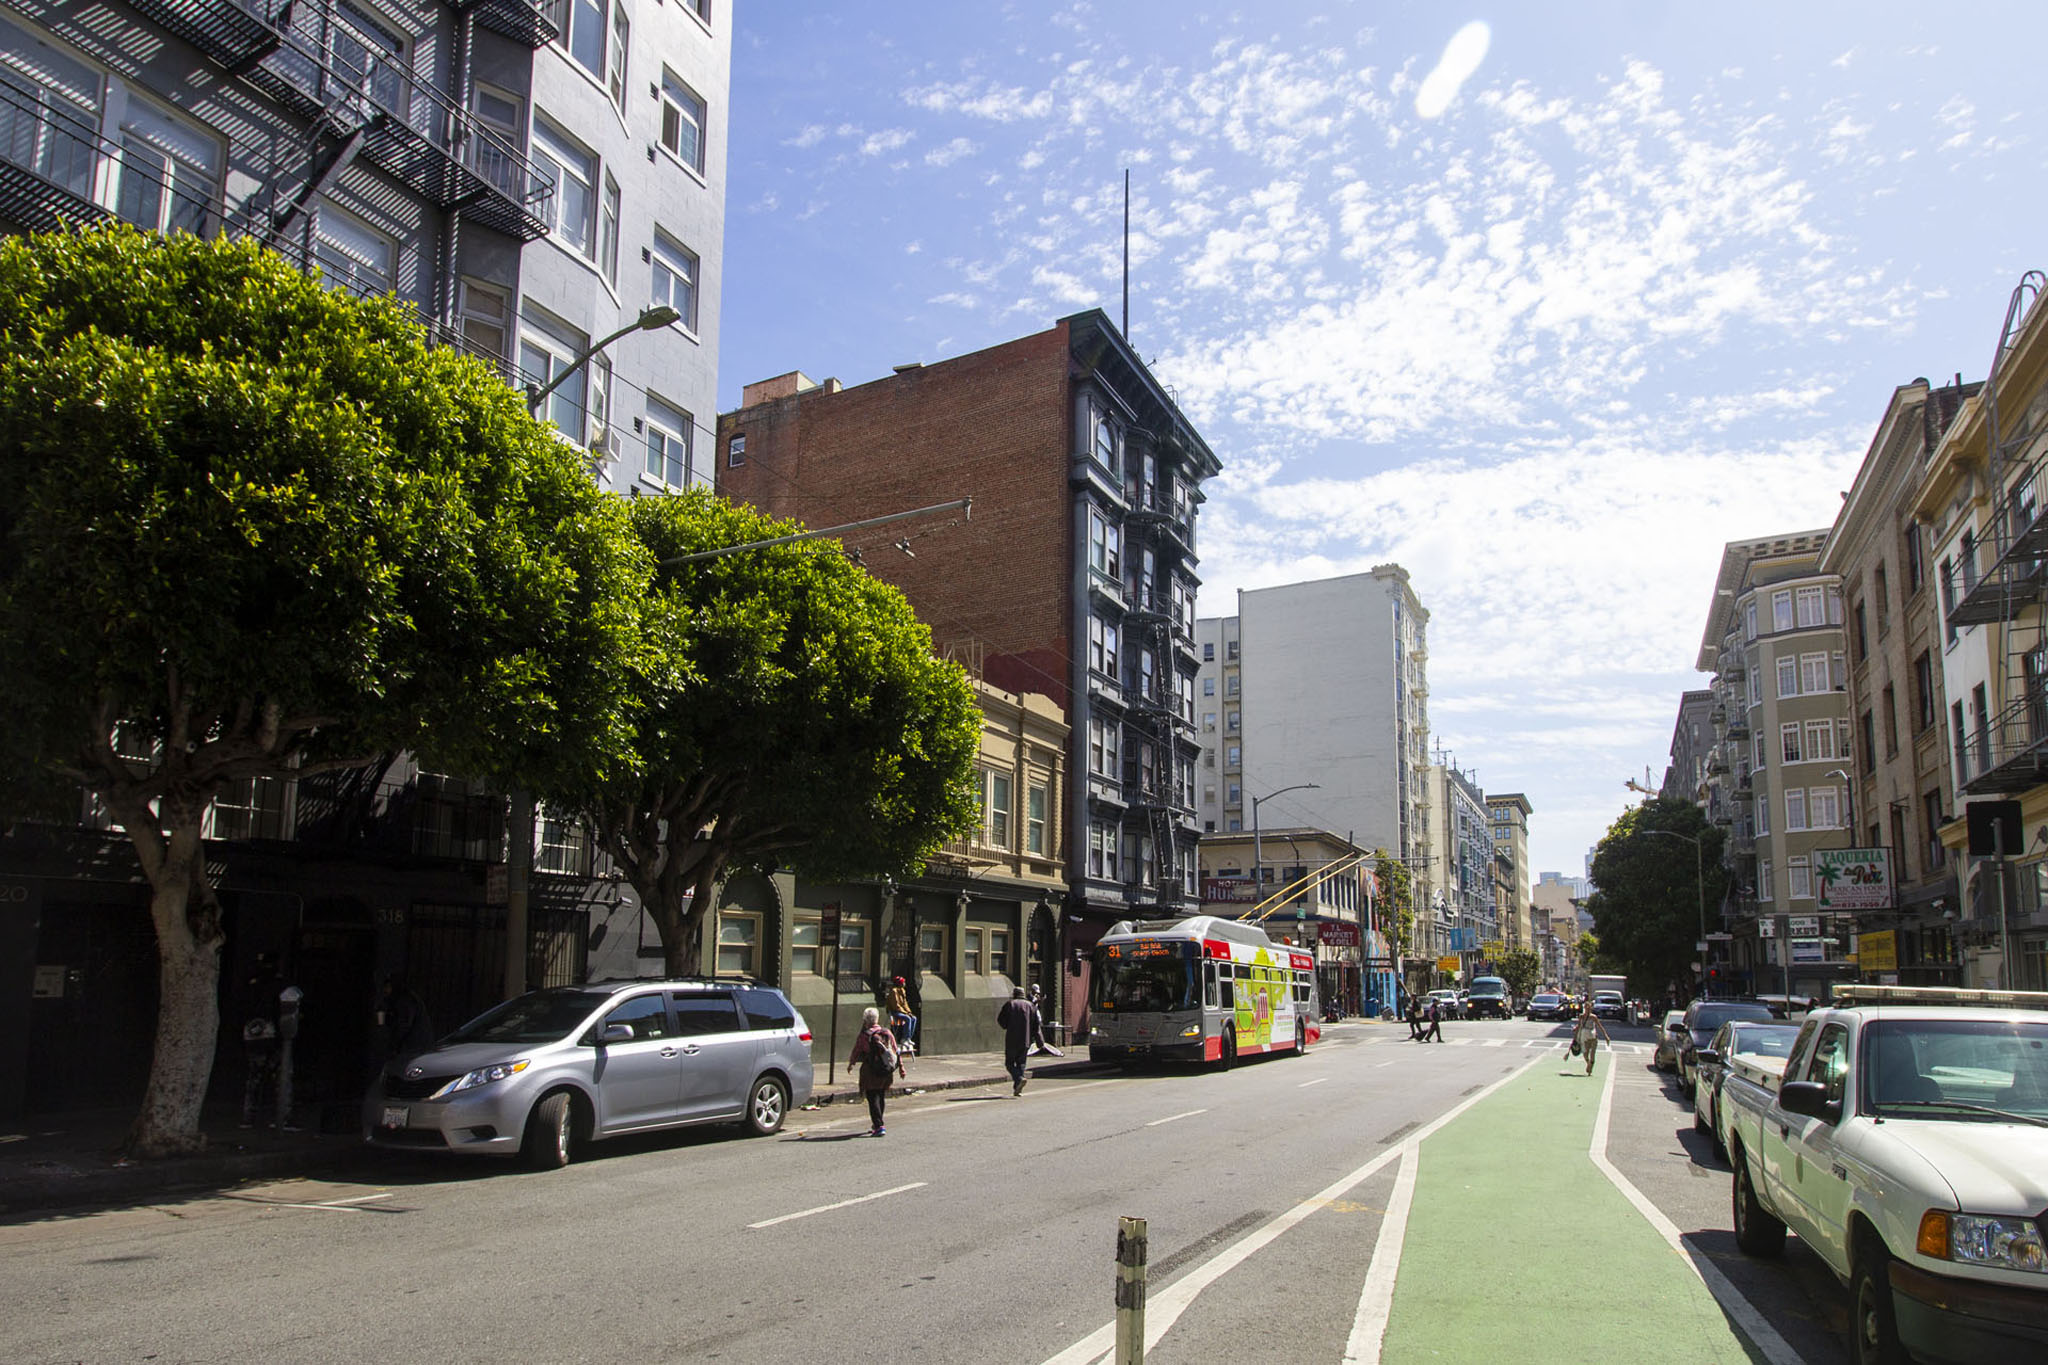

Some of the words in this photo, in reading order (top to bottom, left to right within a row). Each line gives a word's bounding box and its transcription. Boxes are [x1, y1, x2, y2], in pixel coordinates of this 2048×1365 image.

[1821, 850, 1883, 865] TAQUERIA
[1322, 931, 1354, 939] MARKET
[1108, 944, 1121, 958] 31
